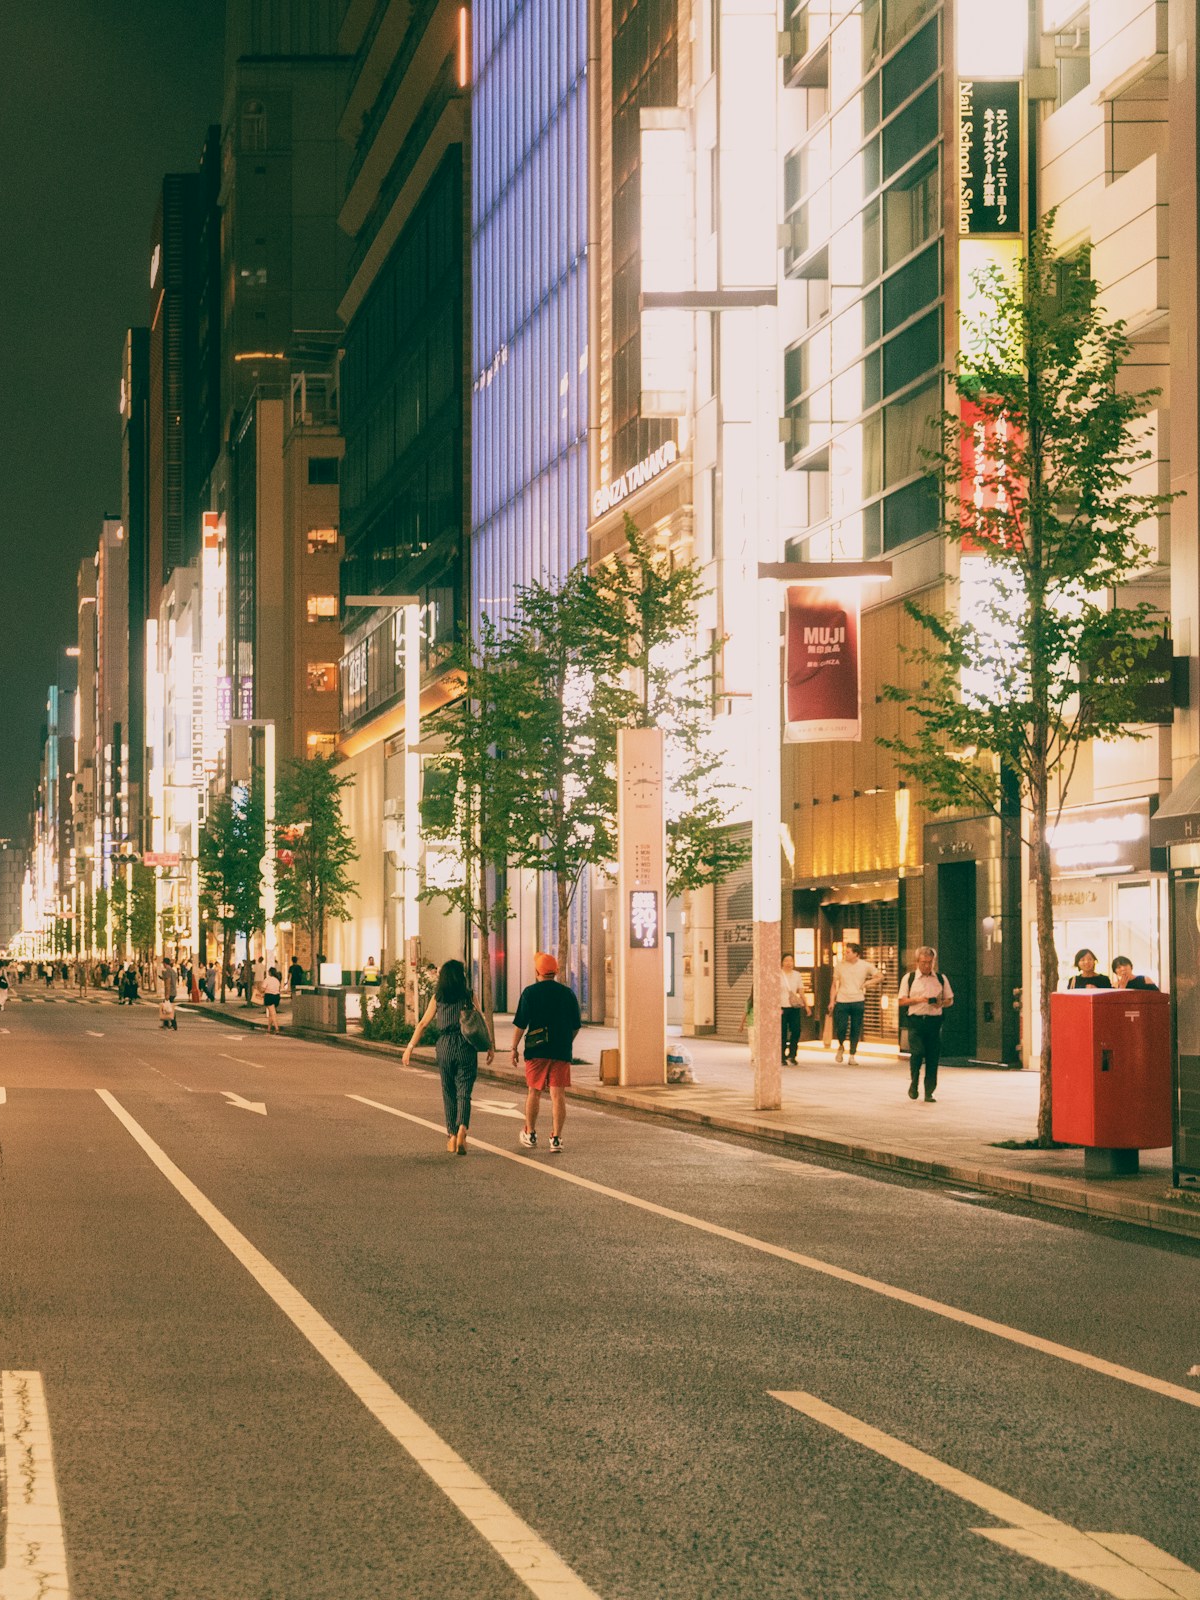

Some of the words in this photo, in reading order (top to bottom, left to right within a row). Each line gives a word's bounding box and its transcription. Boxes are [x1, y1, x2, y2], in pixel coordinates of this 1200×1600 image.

[960, 82, 974, 117] Nail
[593, 474, 628, 517] GINZA
[626, 440, 676, 493] TANAKA
[803, 627, 845, 645] MUJI
[631, 908, 657, 924] 20
[633, 922, 657, 940] 17
